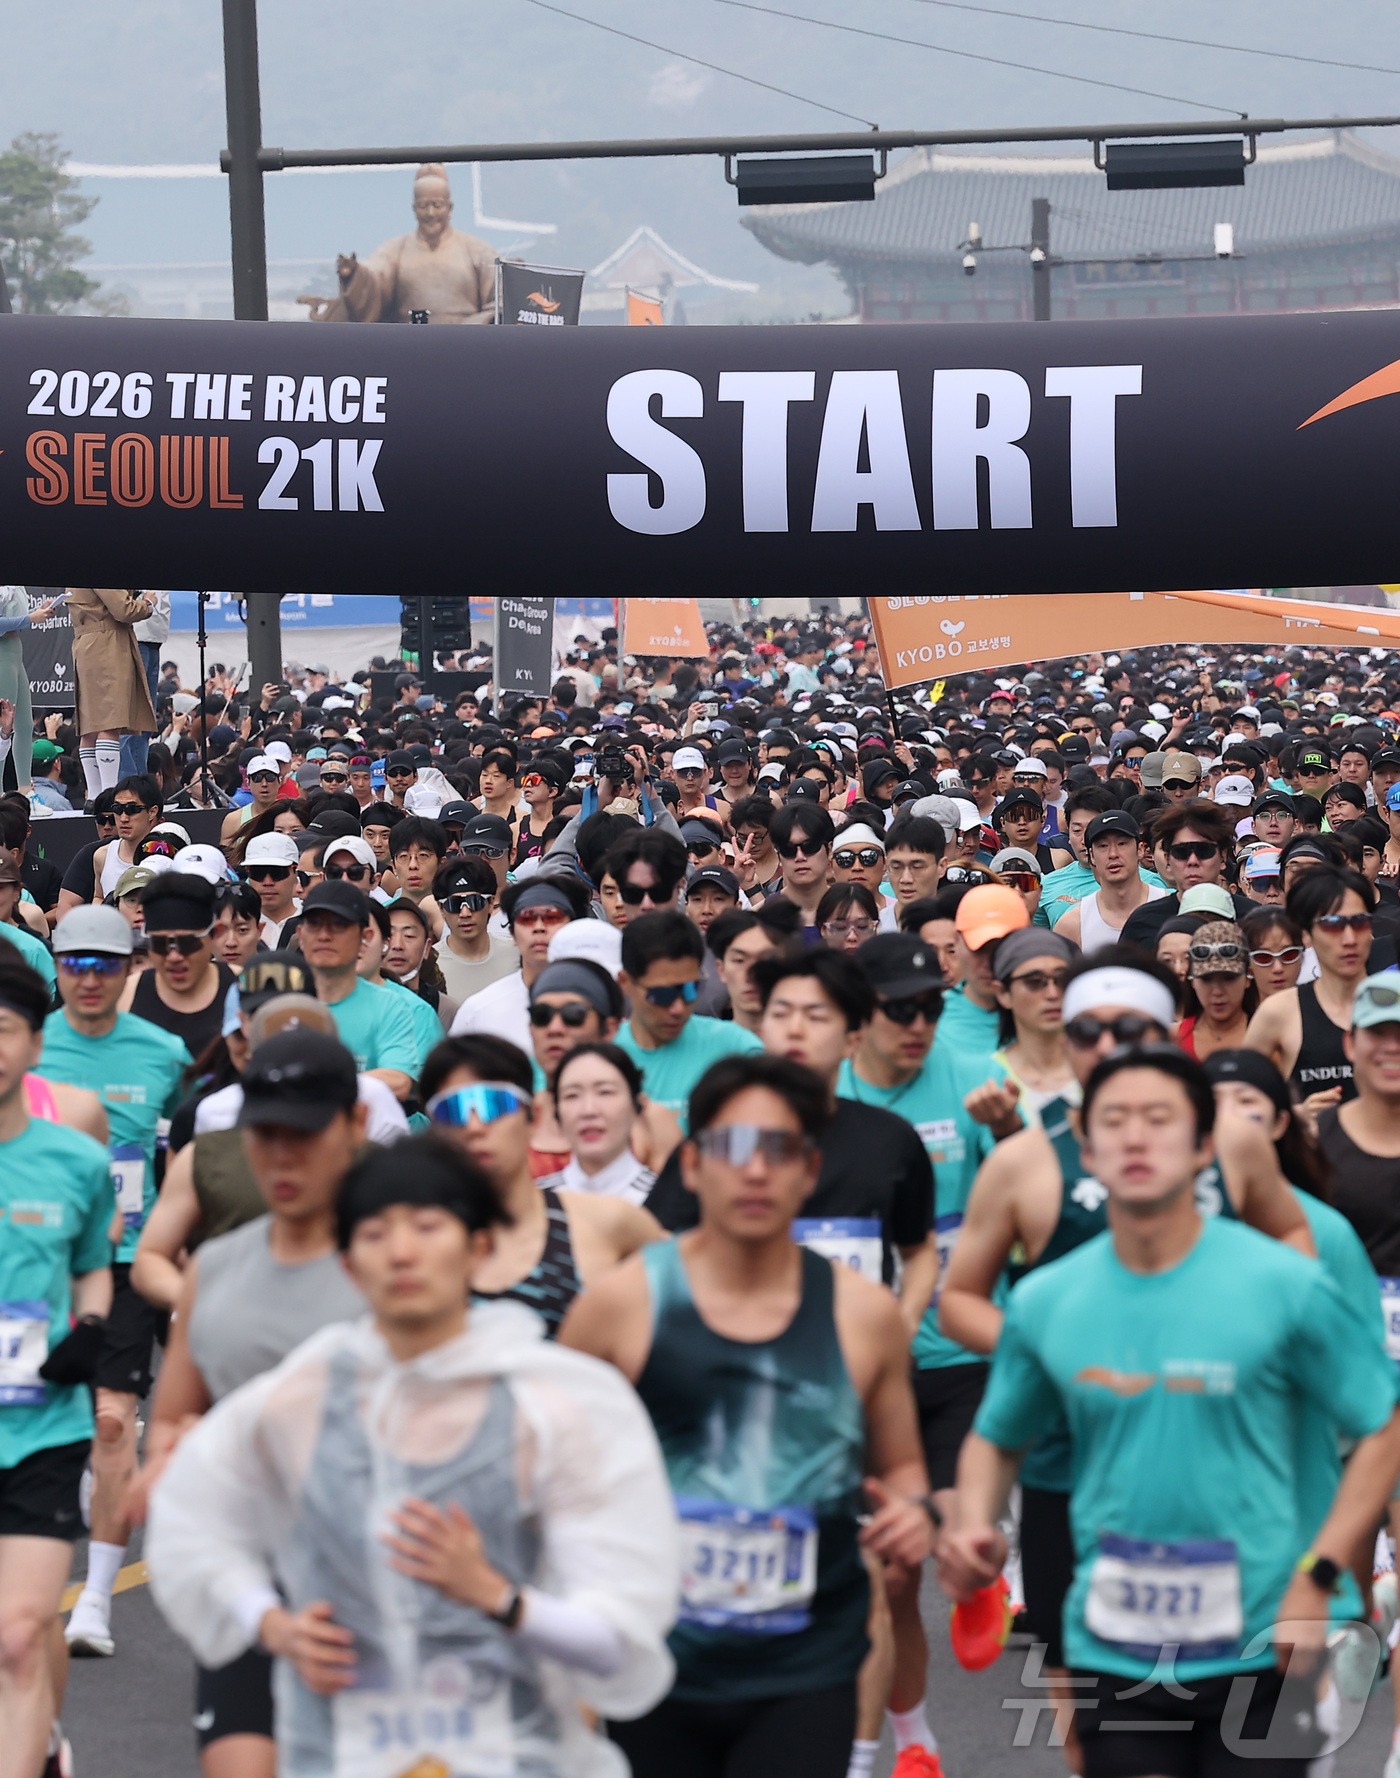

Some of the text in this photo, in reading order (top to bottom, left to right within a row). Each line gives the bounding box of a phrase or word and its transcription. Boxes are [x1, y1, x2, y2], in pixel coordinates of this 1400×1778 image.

[27, 369, 388, 423] 2026 THE RACE
[25, 430, 385, 512] SEOUL 21K
[607, 364, 1143, 535] START
[896, 636, 1012, 668] KYOBO 교보생명
[29, 680, 63, 693] KYOBO
[1300, 1064, 1354, 1082] ENDUR
